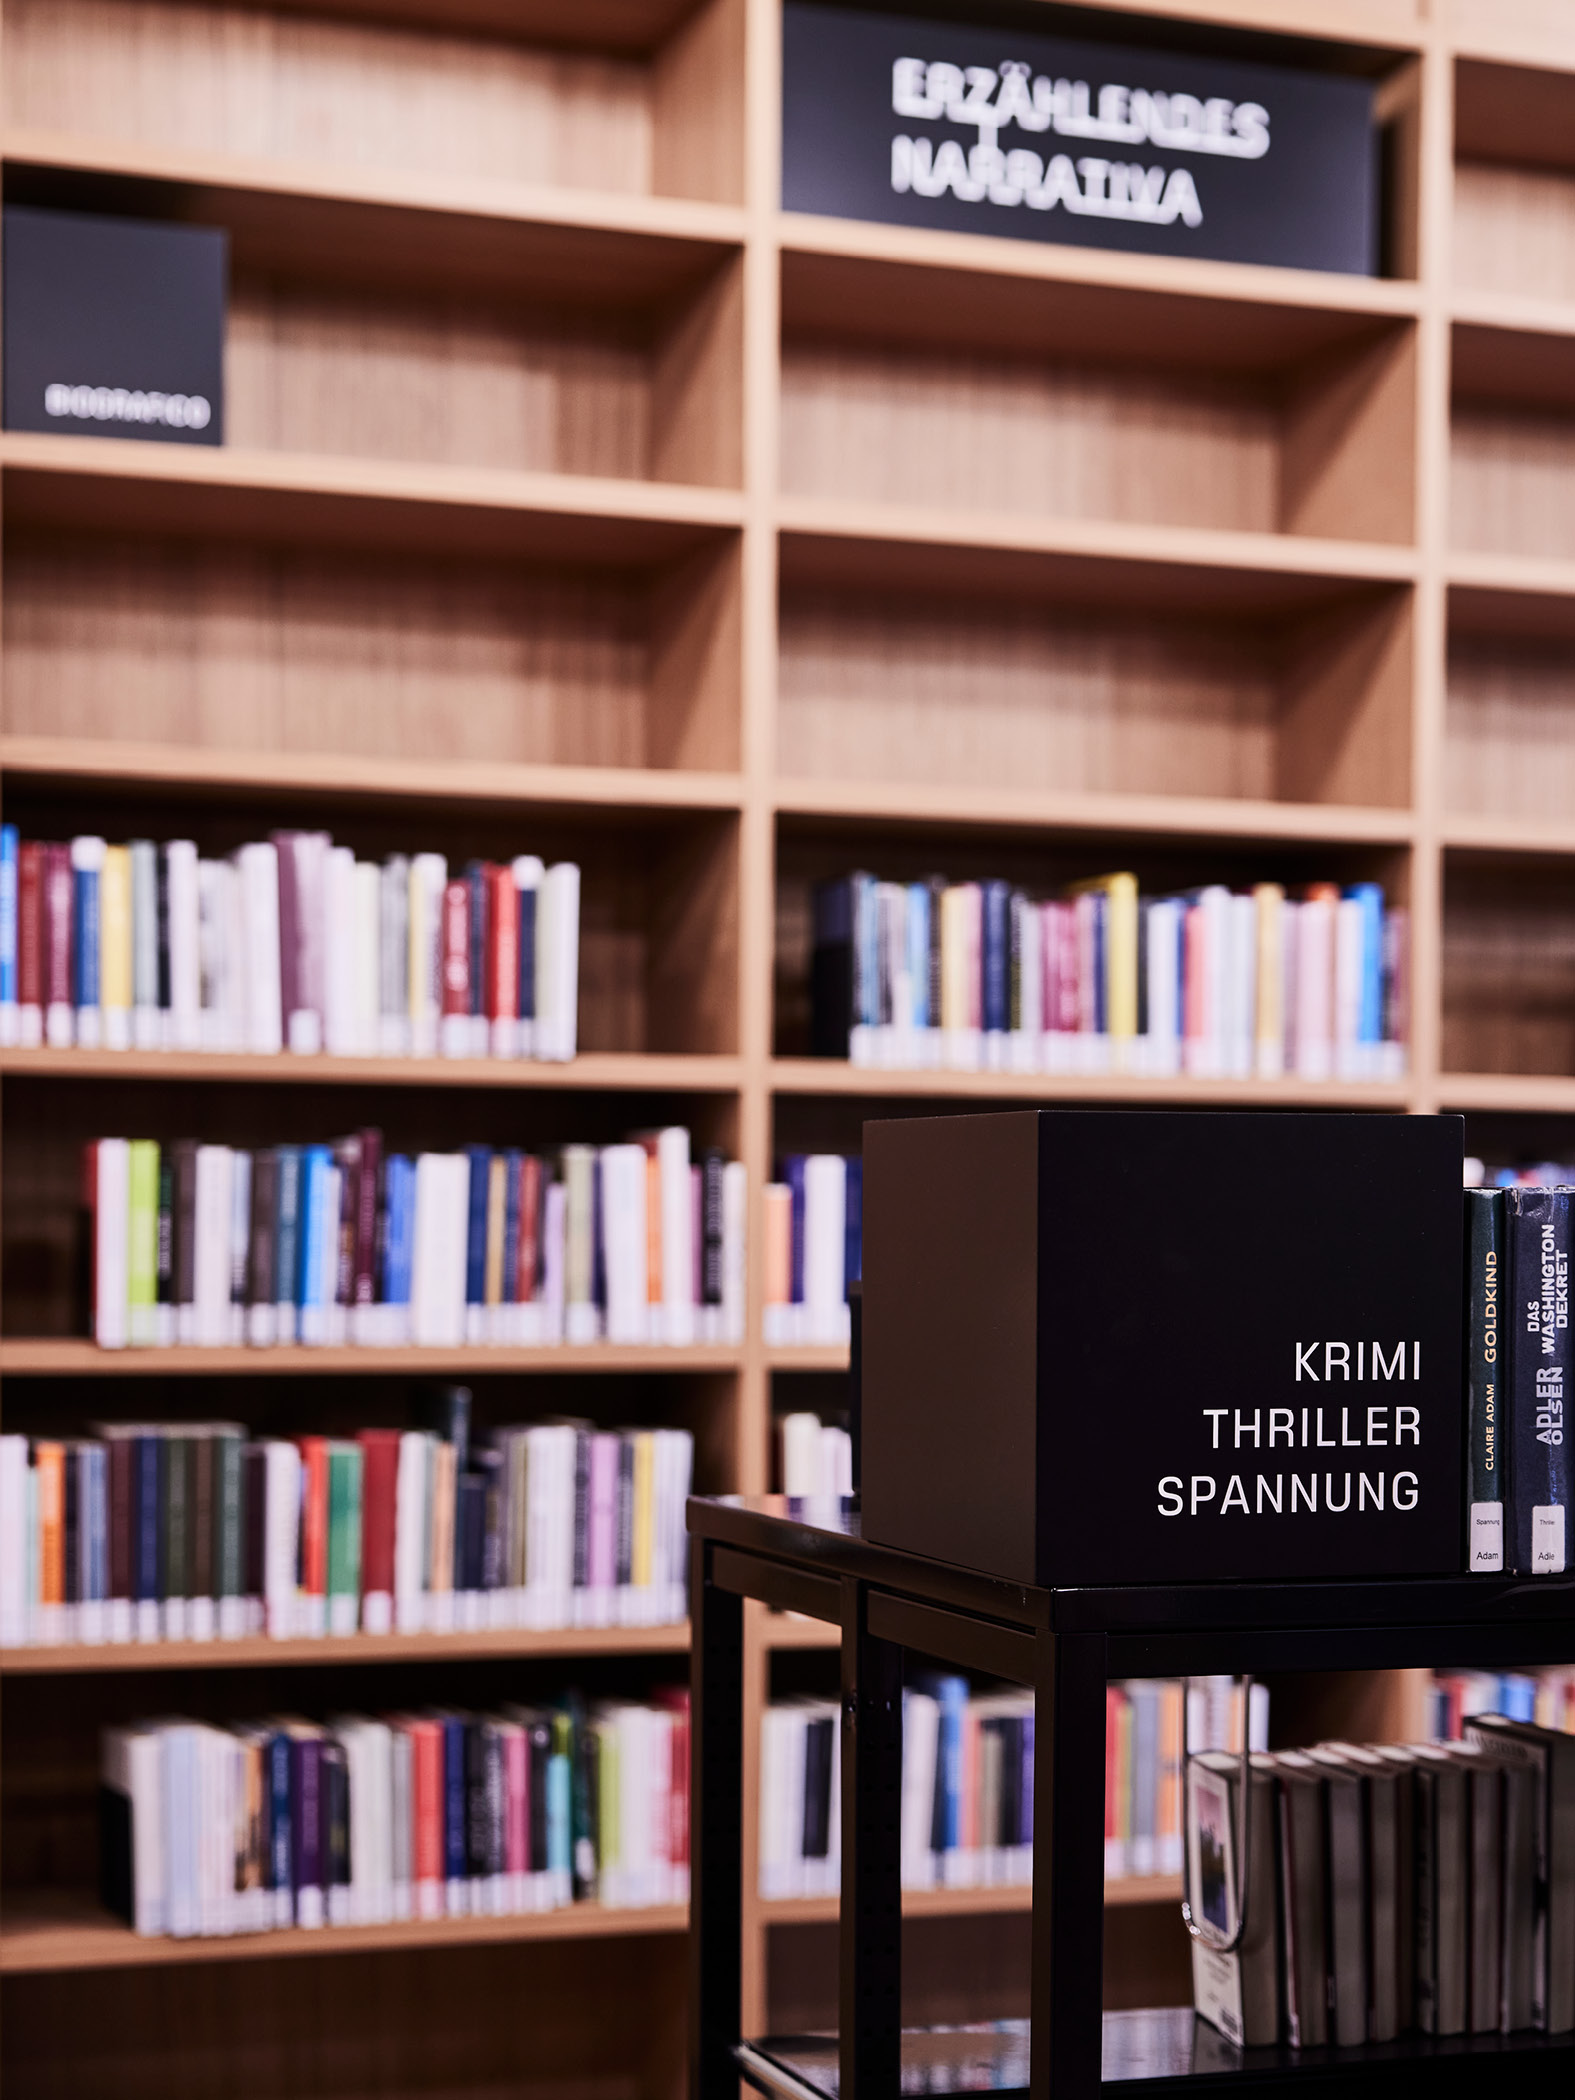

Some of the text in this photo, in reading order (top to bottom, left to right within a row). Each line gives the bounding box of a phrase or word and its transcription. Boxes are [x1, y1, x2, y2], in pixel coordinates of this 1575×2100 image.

[892, 57, 1270, 159] ERZÄHLENDES
[891, 134, 1204, 228] NARRATIVA
[1484, 1251, 1497, 1363] GOLDKIND
[1527, 1300, 1540, 1332] DAS
[1541, 1224, 1555, 1354] WASHINGTON
[1556, 1249, 1568, 1329] DEKRET
[1295, 1341, 1420, 1382] KRIMI
[1203, 1406, 1420, 1449] THRILLER
[1485, 1384, 1495, 1470] CLAIRE ADAM
[1536, 1367, 1551, 1445] ADLER
[1551, 1366, 1564, 1446] OLSEN
[1157, 1471, 1419, 1517] SPANNUNG
[1476, 1551, 1498, 1560] Adam
